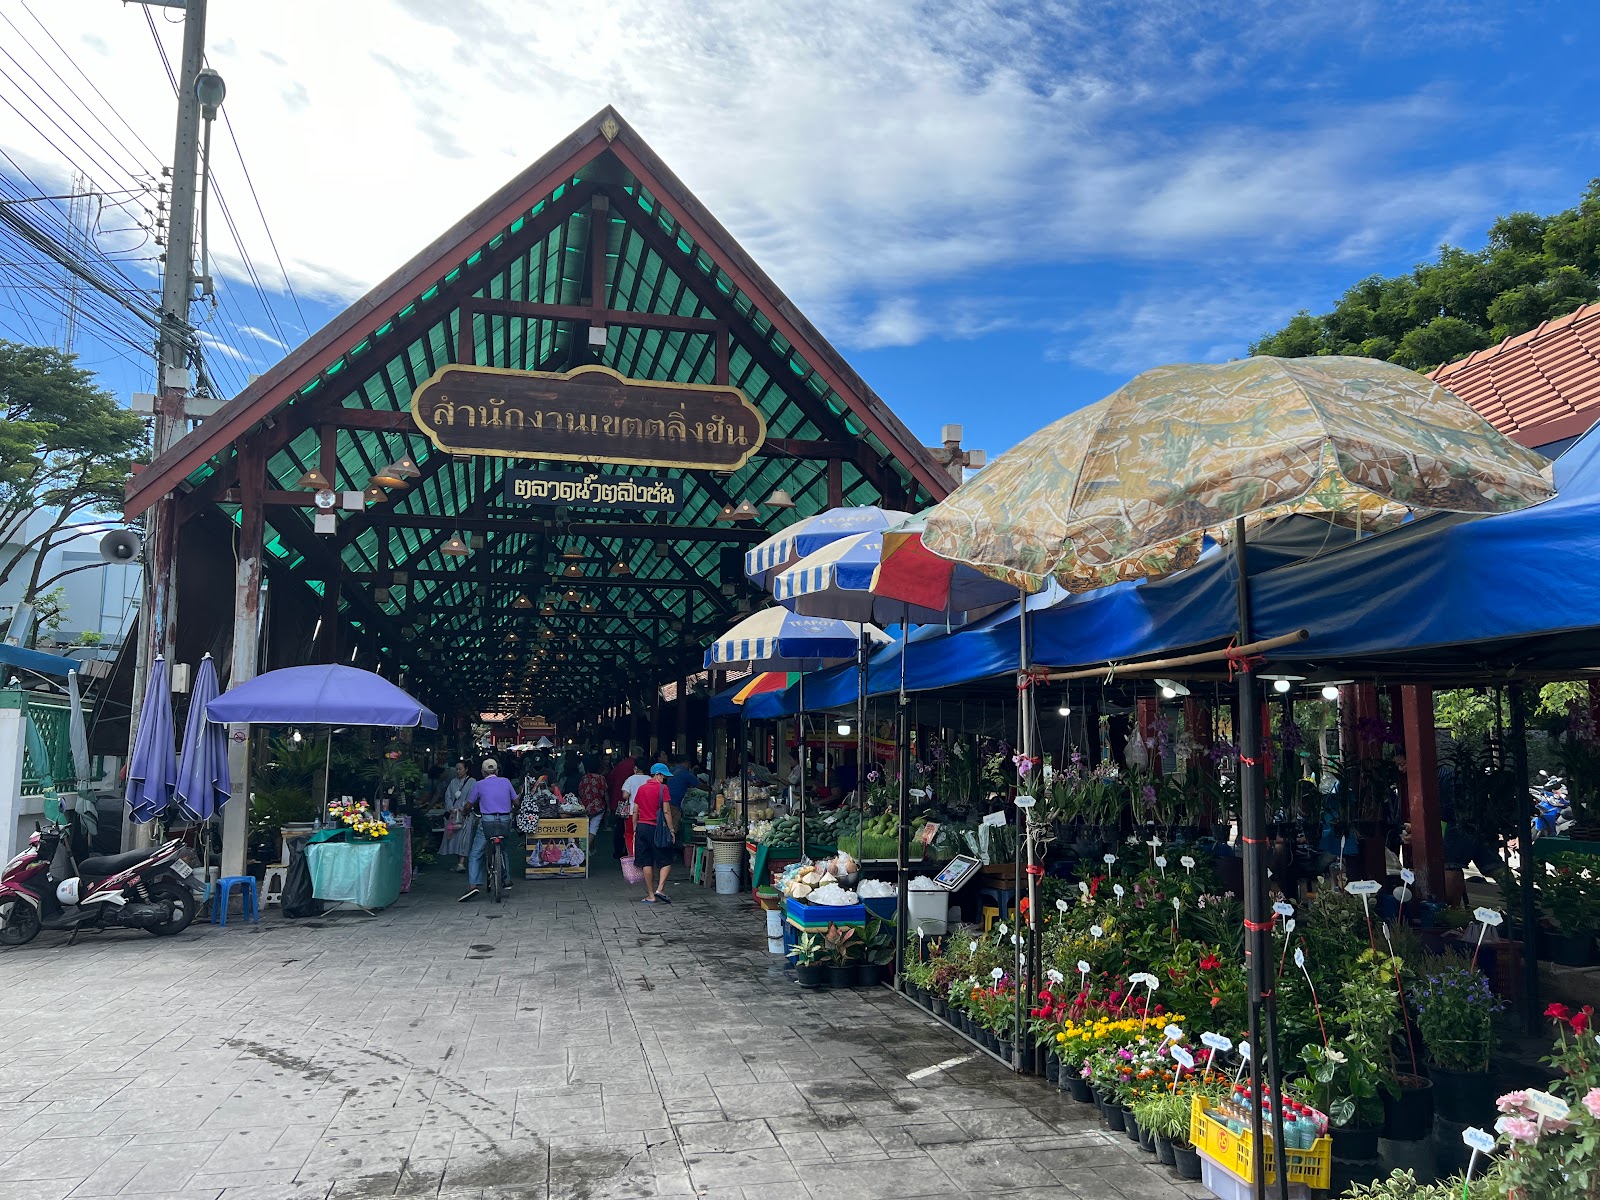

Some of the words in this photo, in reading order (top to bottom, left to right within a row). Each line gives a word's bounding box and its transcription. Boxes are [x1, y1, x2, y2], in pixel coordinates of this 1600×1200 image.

[433, 396, 748, 446] สำนักงานเขตตลิ่งชัน
[514, 473, 675, 504] ตลาดน้ำตลิ่งชัน
[820, 515, 874, 524] TEAPOT
[787, 619, 837, 627] TEAPOT
